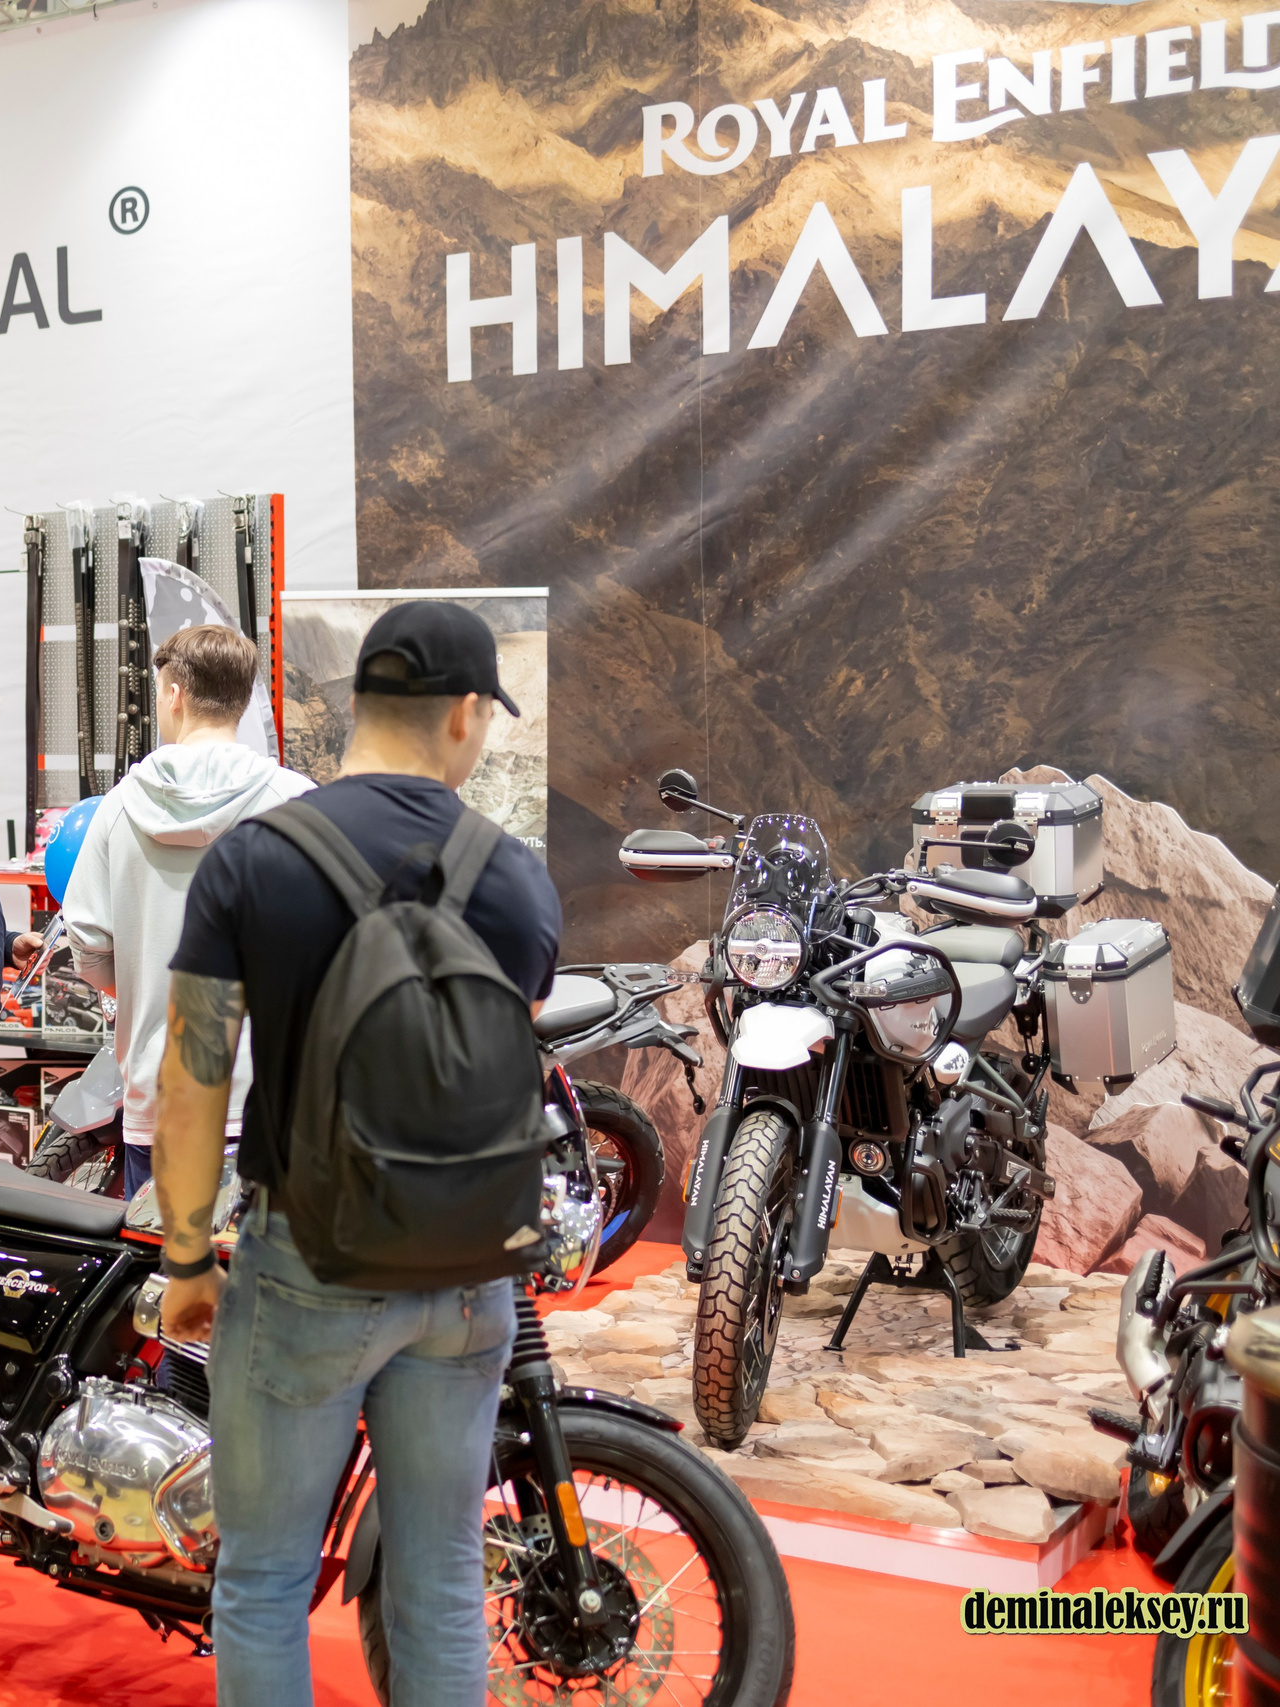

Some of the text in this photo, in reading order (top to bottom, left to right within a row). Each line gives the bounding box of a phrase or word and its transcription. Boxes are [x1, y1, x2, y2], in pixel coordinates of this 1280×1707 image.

[642, 78, 908, 178] ROYAL
[446, 134, 1280, 384] HIMALAY
[690, 1139, 710, 1207] HIMALAYAN
[817, 1159, 837, 1230] HIMALAYAN
